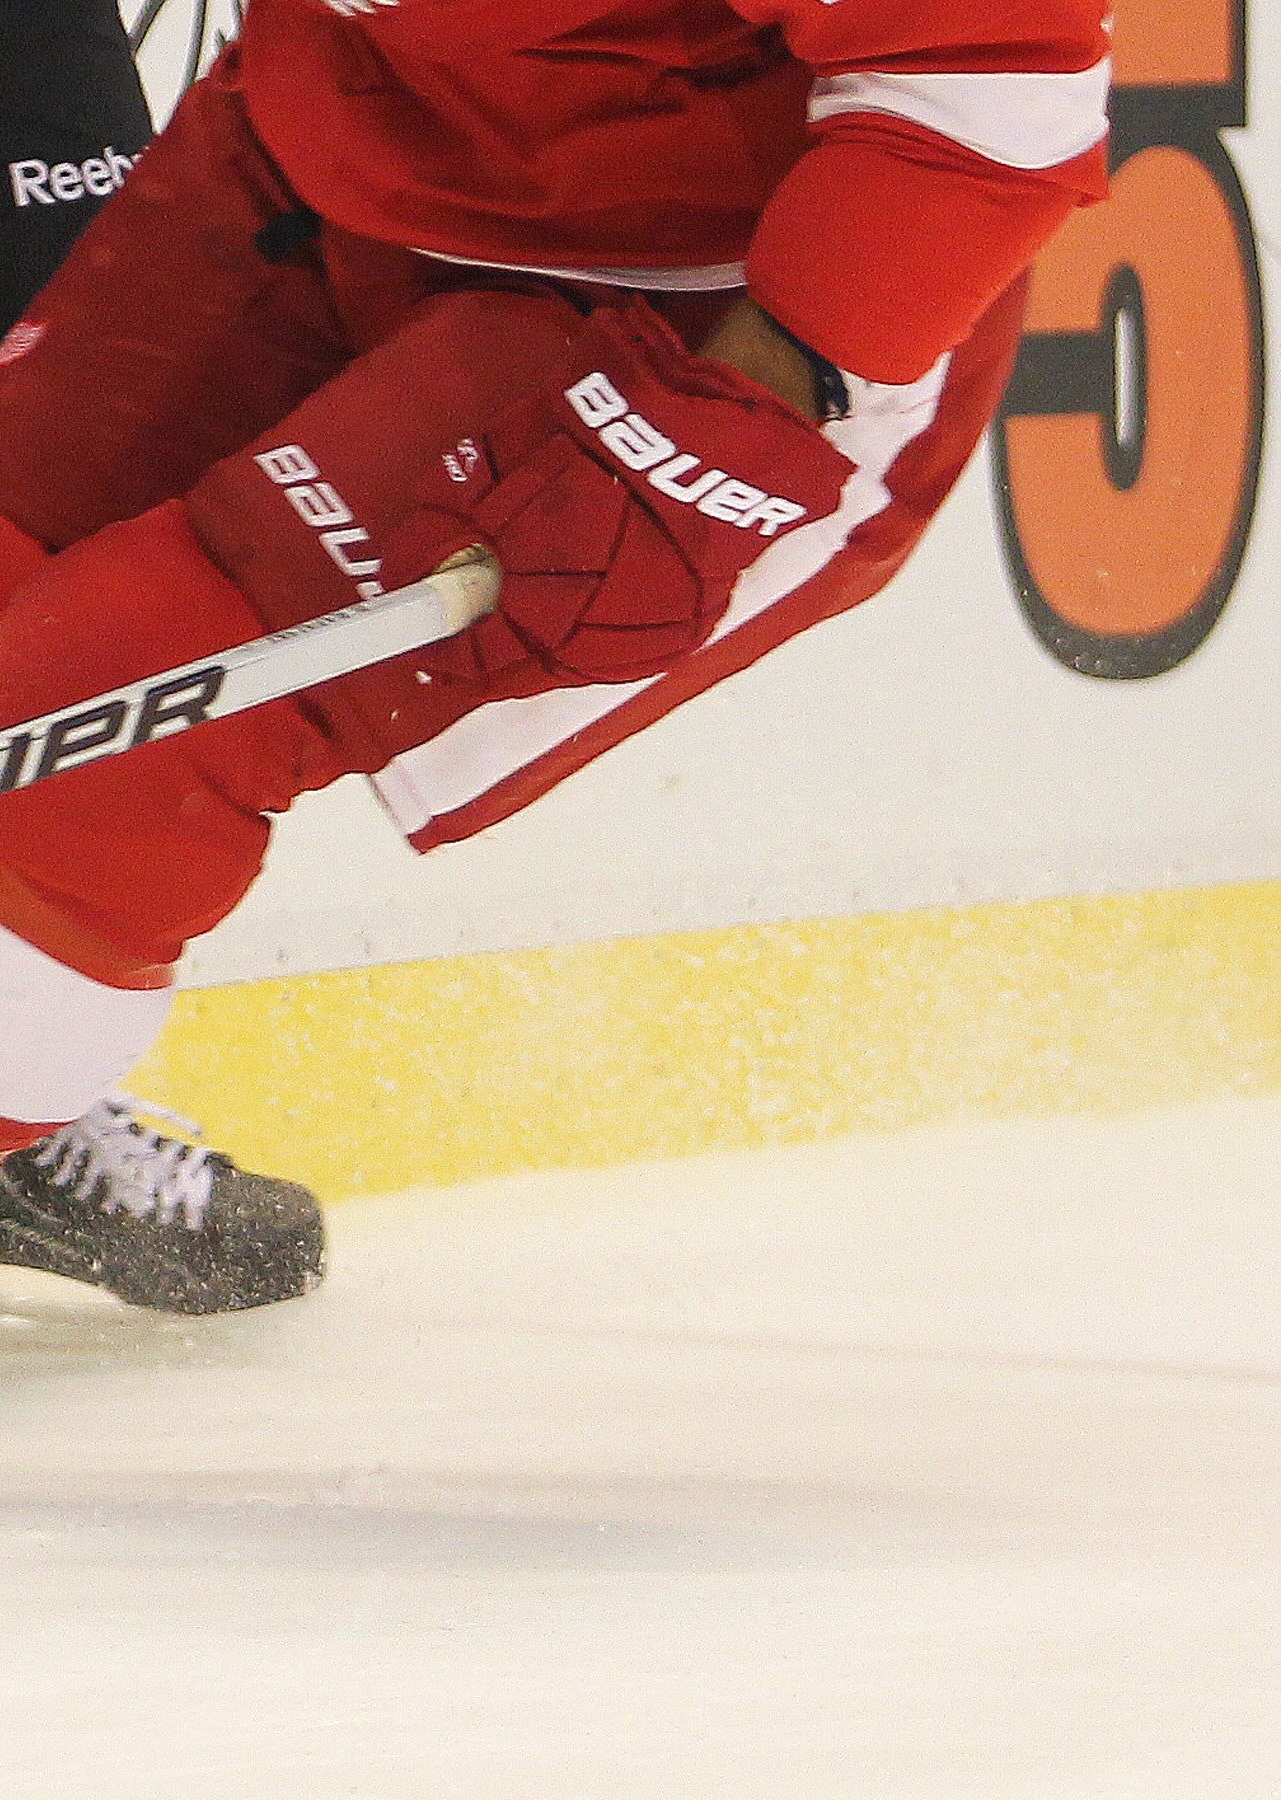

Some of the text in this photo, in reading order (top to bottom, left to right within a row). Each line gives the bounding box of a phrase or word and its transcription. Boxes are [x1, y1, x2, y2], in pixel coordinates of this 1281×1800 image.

[8, 146, 144, 206] Reeb
[253, 443, 386, 600] BAU
[564, 371, 807, 536] BAUER
